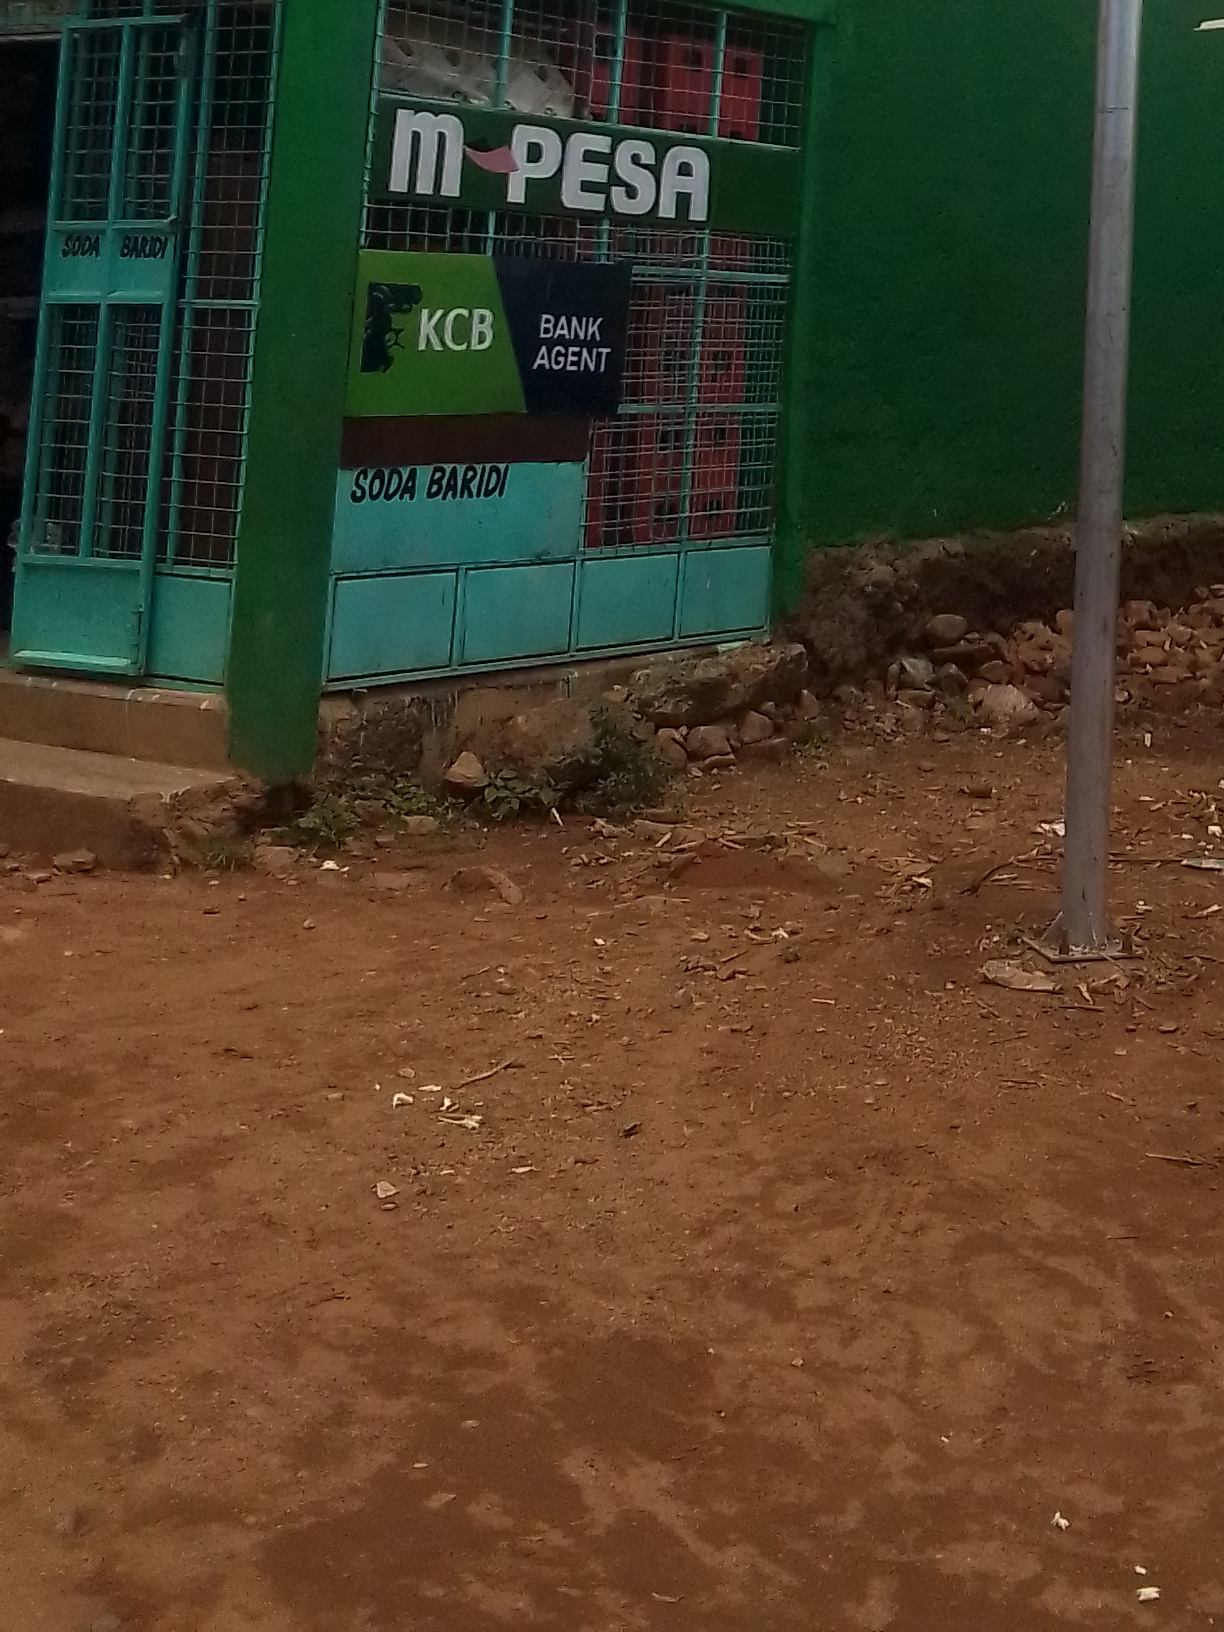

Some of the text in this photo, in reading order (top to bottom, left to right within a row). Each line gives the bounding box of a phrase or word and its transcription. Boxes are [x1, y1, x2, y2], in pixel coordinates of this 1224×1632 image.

[61, 234, 169, 259] SODA BARIDI
[416, 307, 496, 352] KCB
[538, 313, 604, 342] BANK
[532, 347, 612, 373] AGENT
[349, 463, 511, 504] SODA BARIDI
